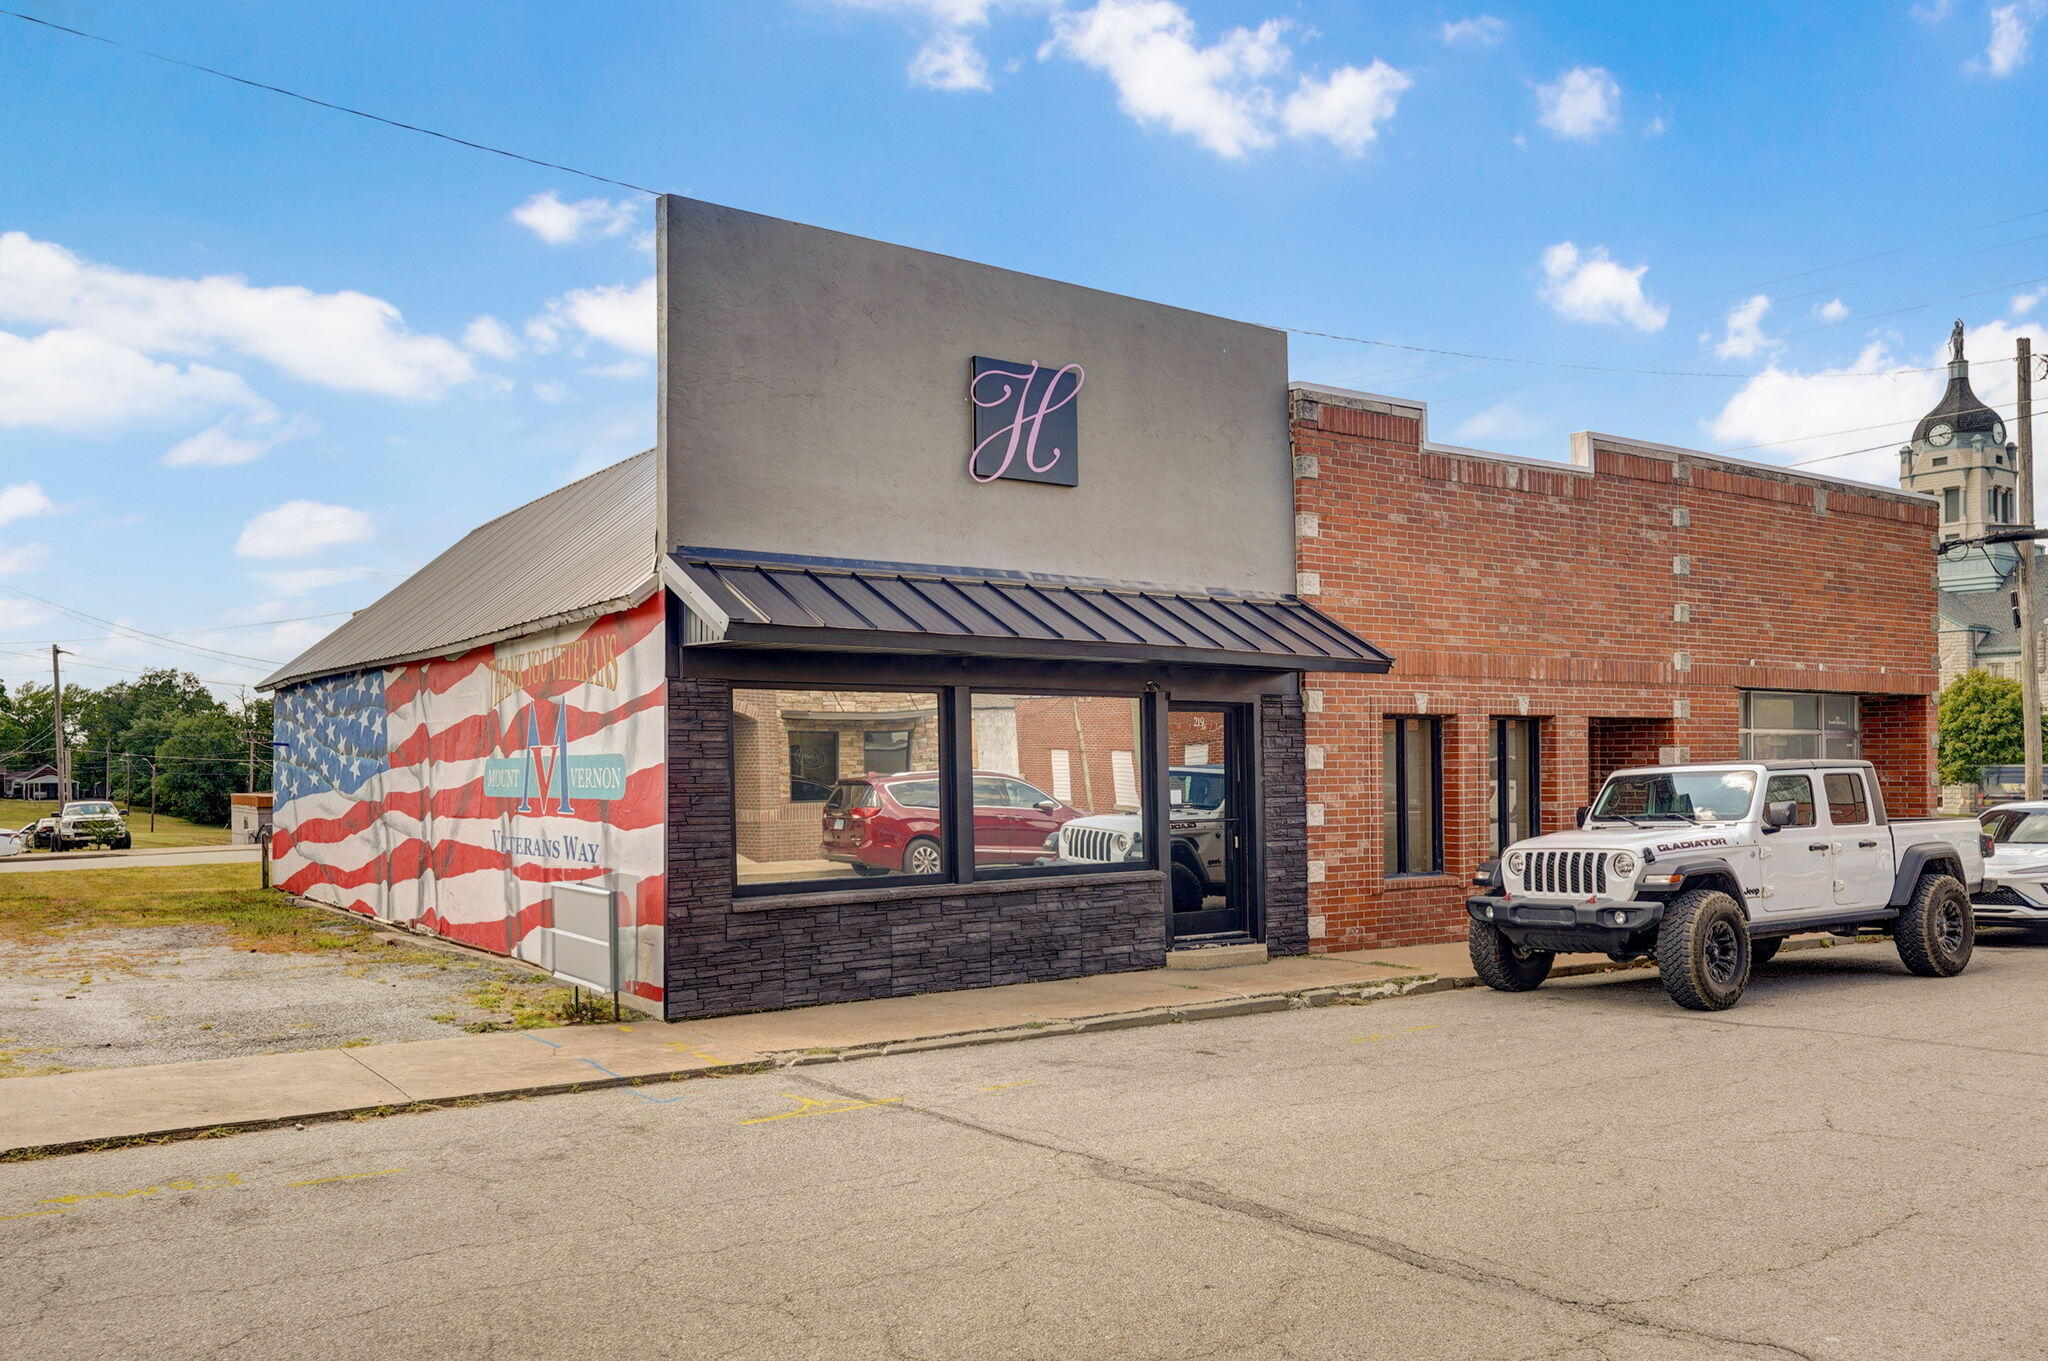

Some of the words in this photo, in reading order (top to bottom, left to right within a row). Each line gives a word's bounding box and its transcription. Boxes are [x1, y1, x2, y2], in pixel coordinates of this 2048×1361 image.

[968, 359, 1086, 483] H
[489, 653, 525, 708] THANK
[526, 647, 549, 688] YOU
[550, 634, 618, 692] VETERANS
[1193, 716, 1205, 727] 219
[488, 768, 520, 788] MOUNT
[570, 767, 621, 789] VERNON
[1657, 838, 1727, 852] GLADIATOR
[1744, 887, 1760, 896] Jeep
